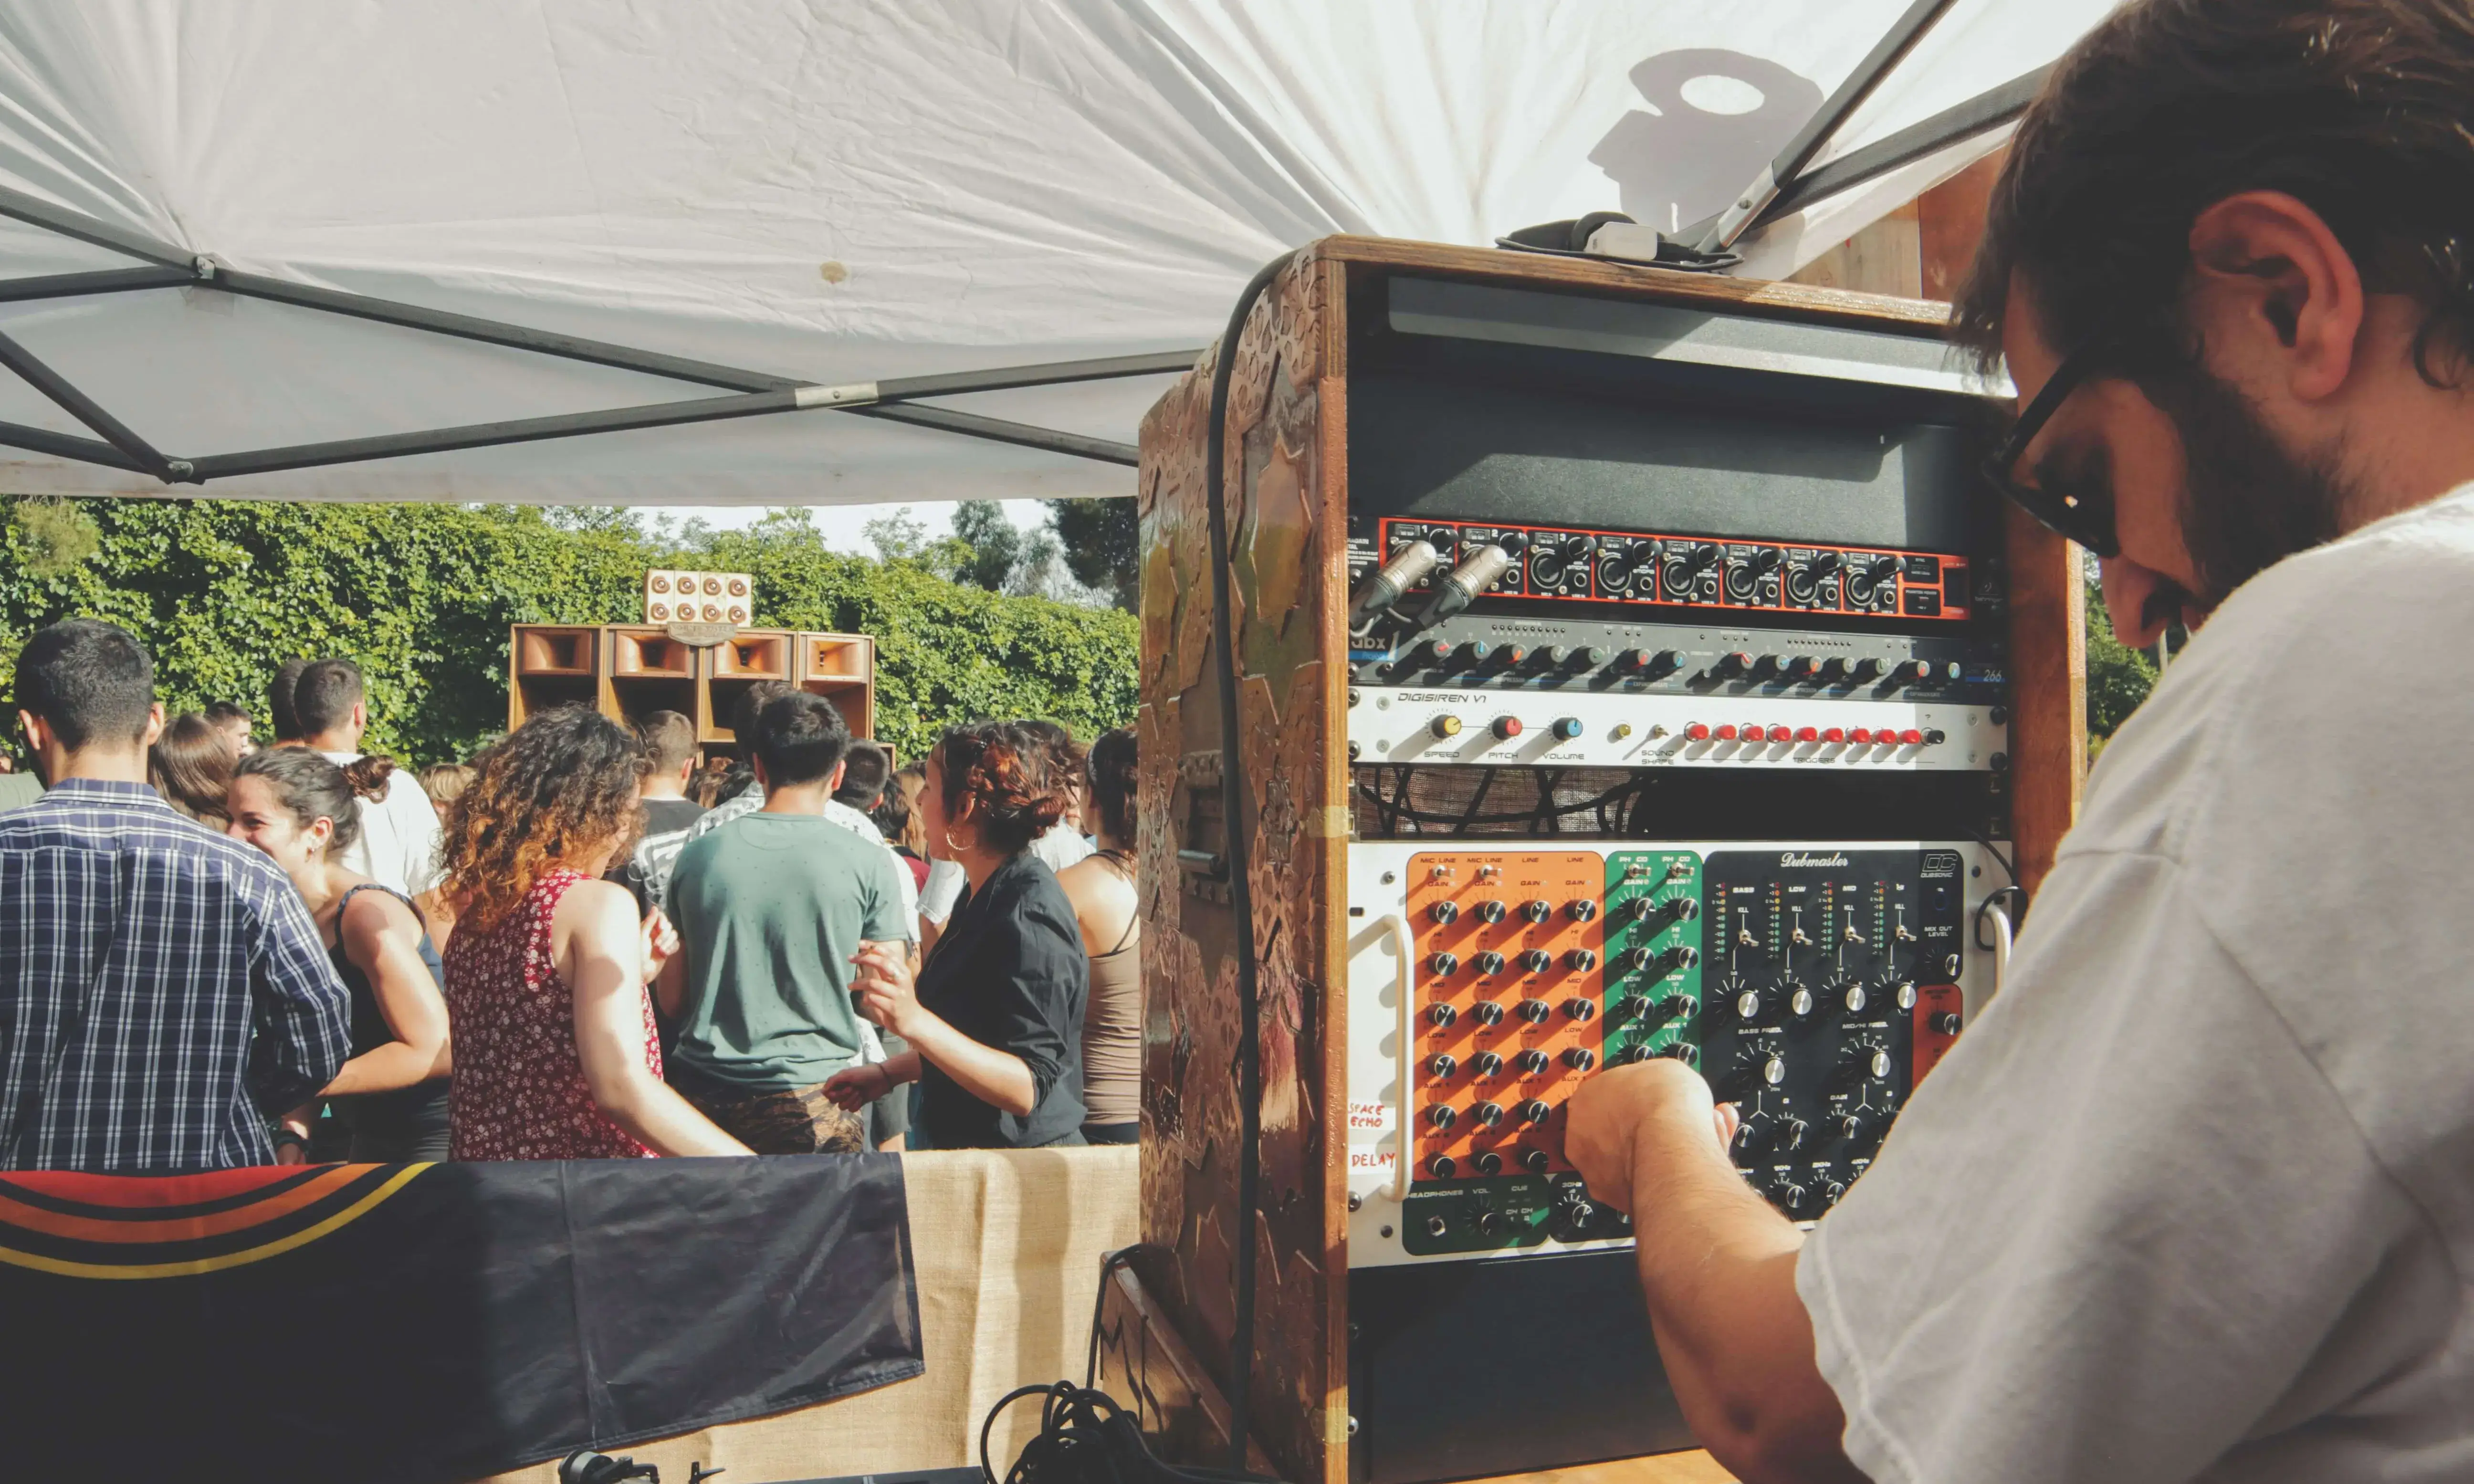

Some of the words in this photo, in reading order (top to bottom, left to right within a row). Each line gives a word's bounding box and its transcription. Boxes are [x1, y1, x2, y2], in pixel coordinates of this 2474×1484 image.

[1421, 525, 1428, 533] 1
[1492, 529, 1499, 537] 2
[1560, 533, 1566, 542] 3
[1625, 538, 1632, 546] 4
[1984, 669, 2002, 682] 266
[1398, 693, 1468, 702] DIGISIREN
[1781, 852, 1848, 867] Dubmaster
[1349, 1103, 1385, 1115] SPACE
[1351, 1116, 1383, 1127] ECHO
[1352, 1152, 1395, 1169] DELAY
[1408, 1190, 1463, 1198] HEADPHONES
